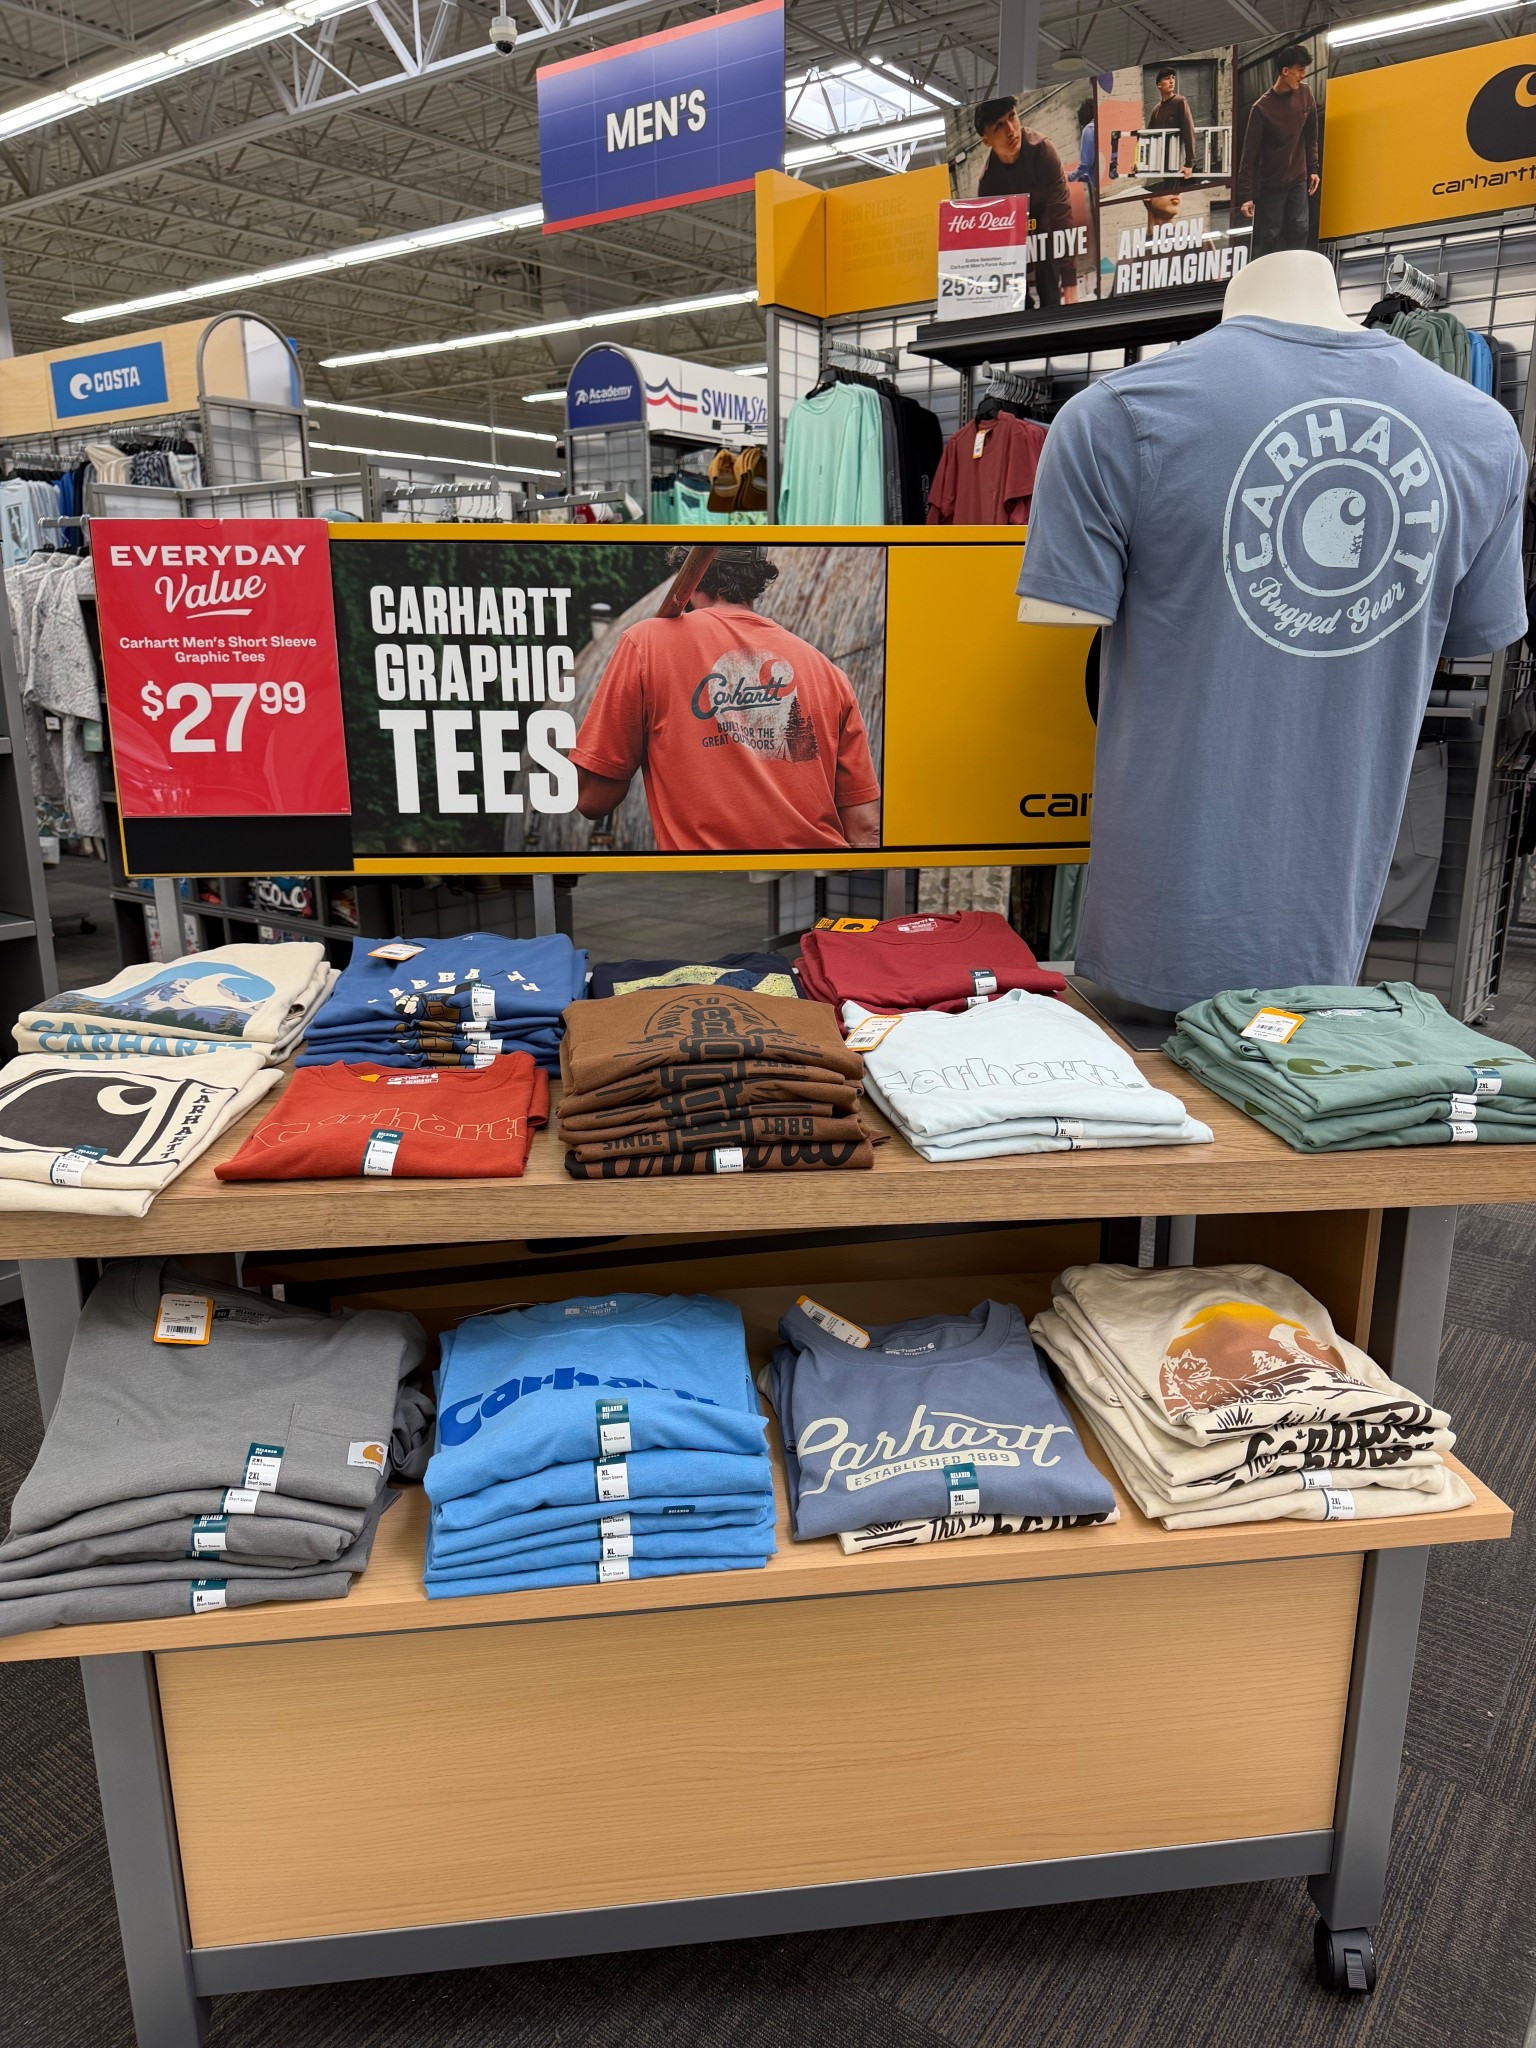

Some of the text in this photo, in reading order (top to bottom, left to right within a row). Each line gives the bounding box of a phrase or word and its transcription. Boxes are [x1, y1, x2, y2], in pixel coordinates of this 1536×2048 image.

[606, 89, 707, 153] MEN'S
[1432, 165, 1536, 195] carhartt
[948, 215, 977, 233] Hot
[979, 211, 1016, 230] Deal
[1053, 226, 1088, 259] DYE
[1118, 217, 1204, 260] AN ICON
[1116, 245, 1249, 294] REIMAGINED
[942, 275, 982, 297] 25%
[94, 366, 141, 393] COSTA
[589, 385, 632, 400] Academy
[702, 388, 747, 422] SWIM
[1235, 409, 1440, 584] CARHARTT
[110, 545, 306, 567] EVERYDAY
[155, 570, 266, 613] Value
[1249, 576, 1405, 637] Rugged Gear
[369, 585, 571, 636] CARHARTT
[119, 636, 317, 650] Carhartt Men's Short Sleeve
[175, 651, 265, 664] Graphic Tees
[374, 644, 576, 703] GRAPHIC
[691, 673, 787, 720] Carhartt
[702, 734, 729, 748] GREAT
[741, 726, 755, 738] FOR
[758, 727, 774, 738] THE
[379, 709, 579, 814] TEES
[160, 1088, 219, 1159] CARHARTT
[761, 1117, 814, 1137] 1889
[602, 1412, 610, 1420] FIT
[248, 1472, 260, 1480] 2XL
[855, 1452, 1010, 1487] ESTABLISHED 1889
[929, 1516, 966, 1542] This
